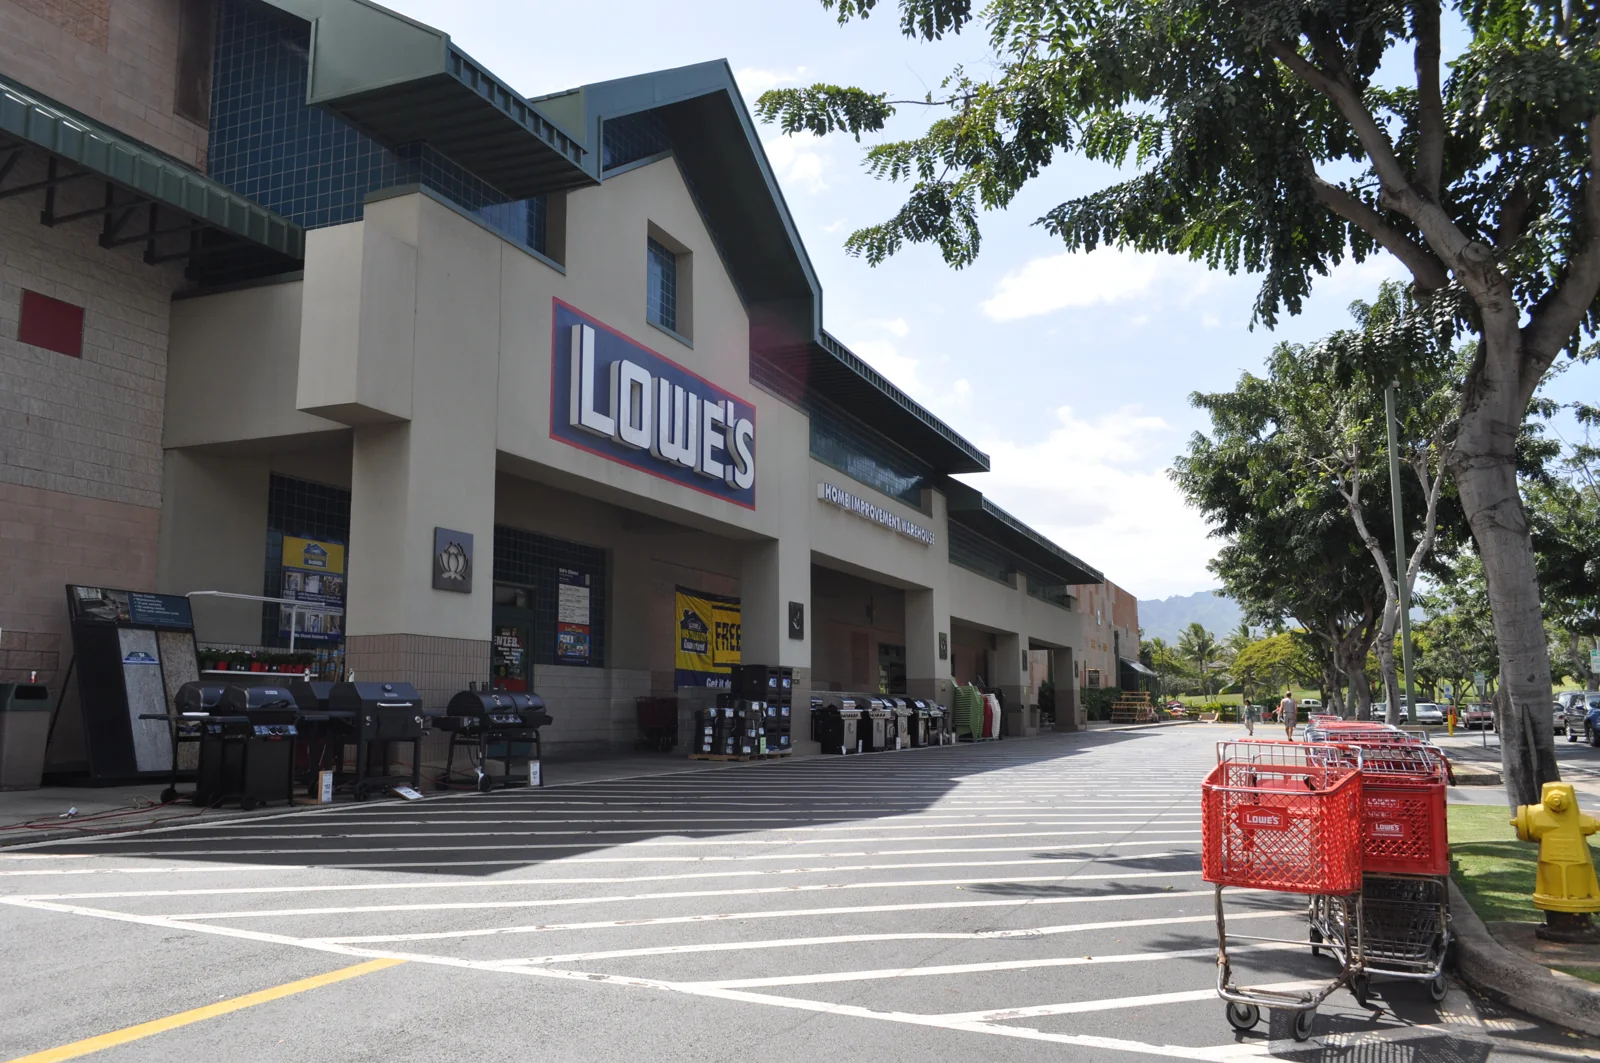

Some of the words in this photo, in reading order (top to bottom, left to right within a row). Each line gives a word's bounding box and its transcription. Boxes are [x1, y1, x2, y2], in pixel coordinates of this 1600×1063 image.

[570, 324, 754, 490] LOWE'S
[825, 483, 849, 508] HOME
[851, 495, 901, 531] IMPROVEMENT
[901, 518, 935, 545] WAREHOUSE
[706, 677, 718, 688] Get
[1246, 813, 1280, 825] LOWE'S
[1375, 823, 1400, 831] LOWE'S
